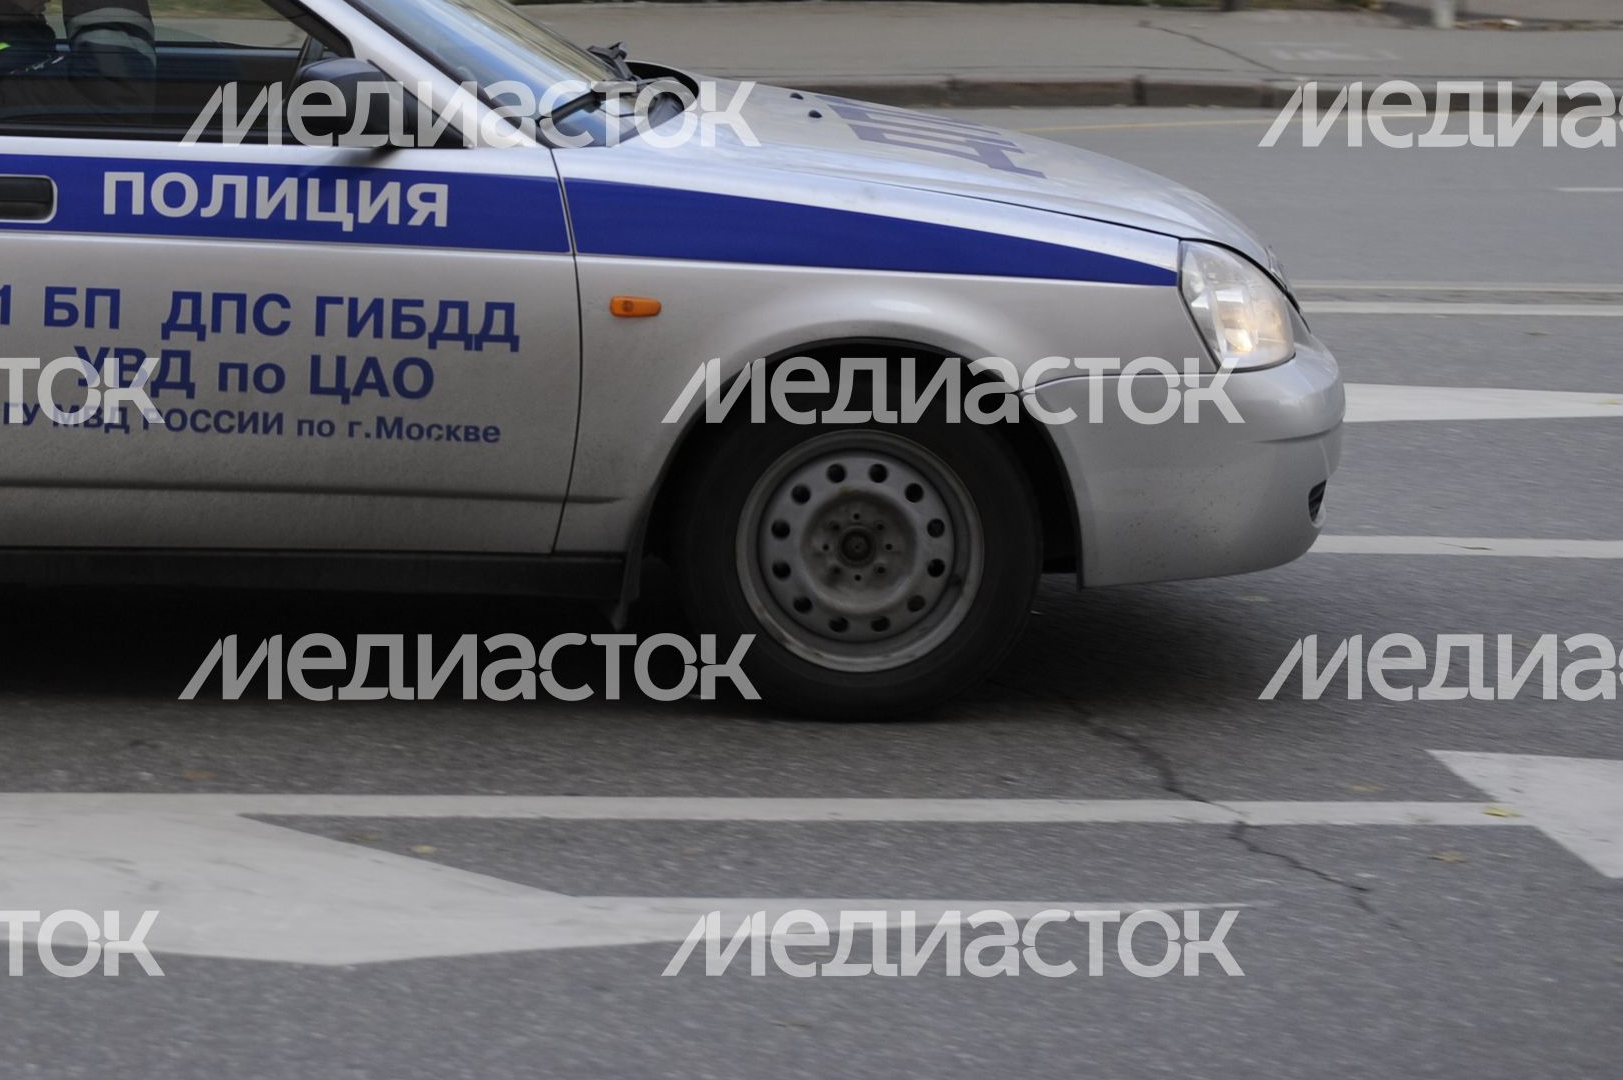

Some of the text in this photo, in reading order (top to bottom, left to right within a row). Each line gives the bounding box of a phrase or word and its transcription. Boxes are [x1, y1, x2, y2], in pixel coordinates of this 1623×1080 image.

[103, 170, 450, 233] ПОЛИЦИЯ
[43, 286, 121, 330] БП
[161, 291, 292, 342] ДПС
[315, 296, 520, 353] ГИБДД
[73, 345, 435, 406] УВД по ЦАО
[52, 402, 131, 434] МВД
[142, 405, 284, 436] РОССИИ
[296, 418, 337, 438] по
